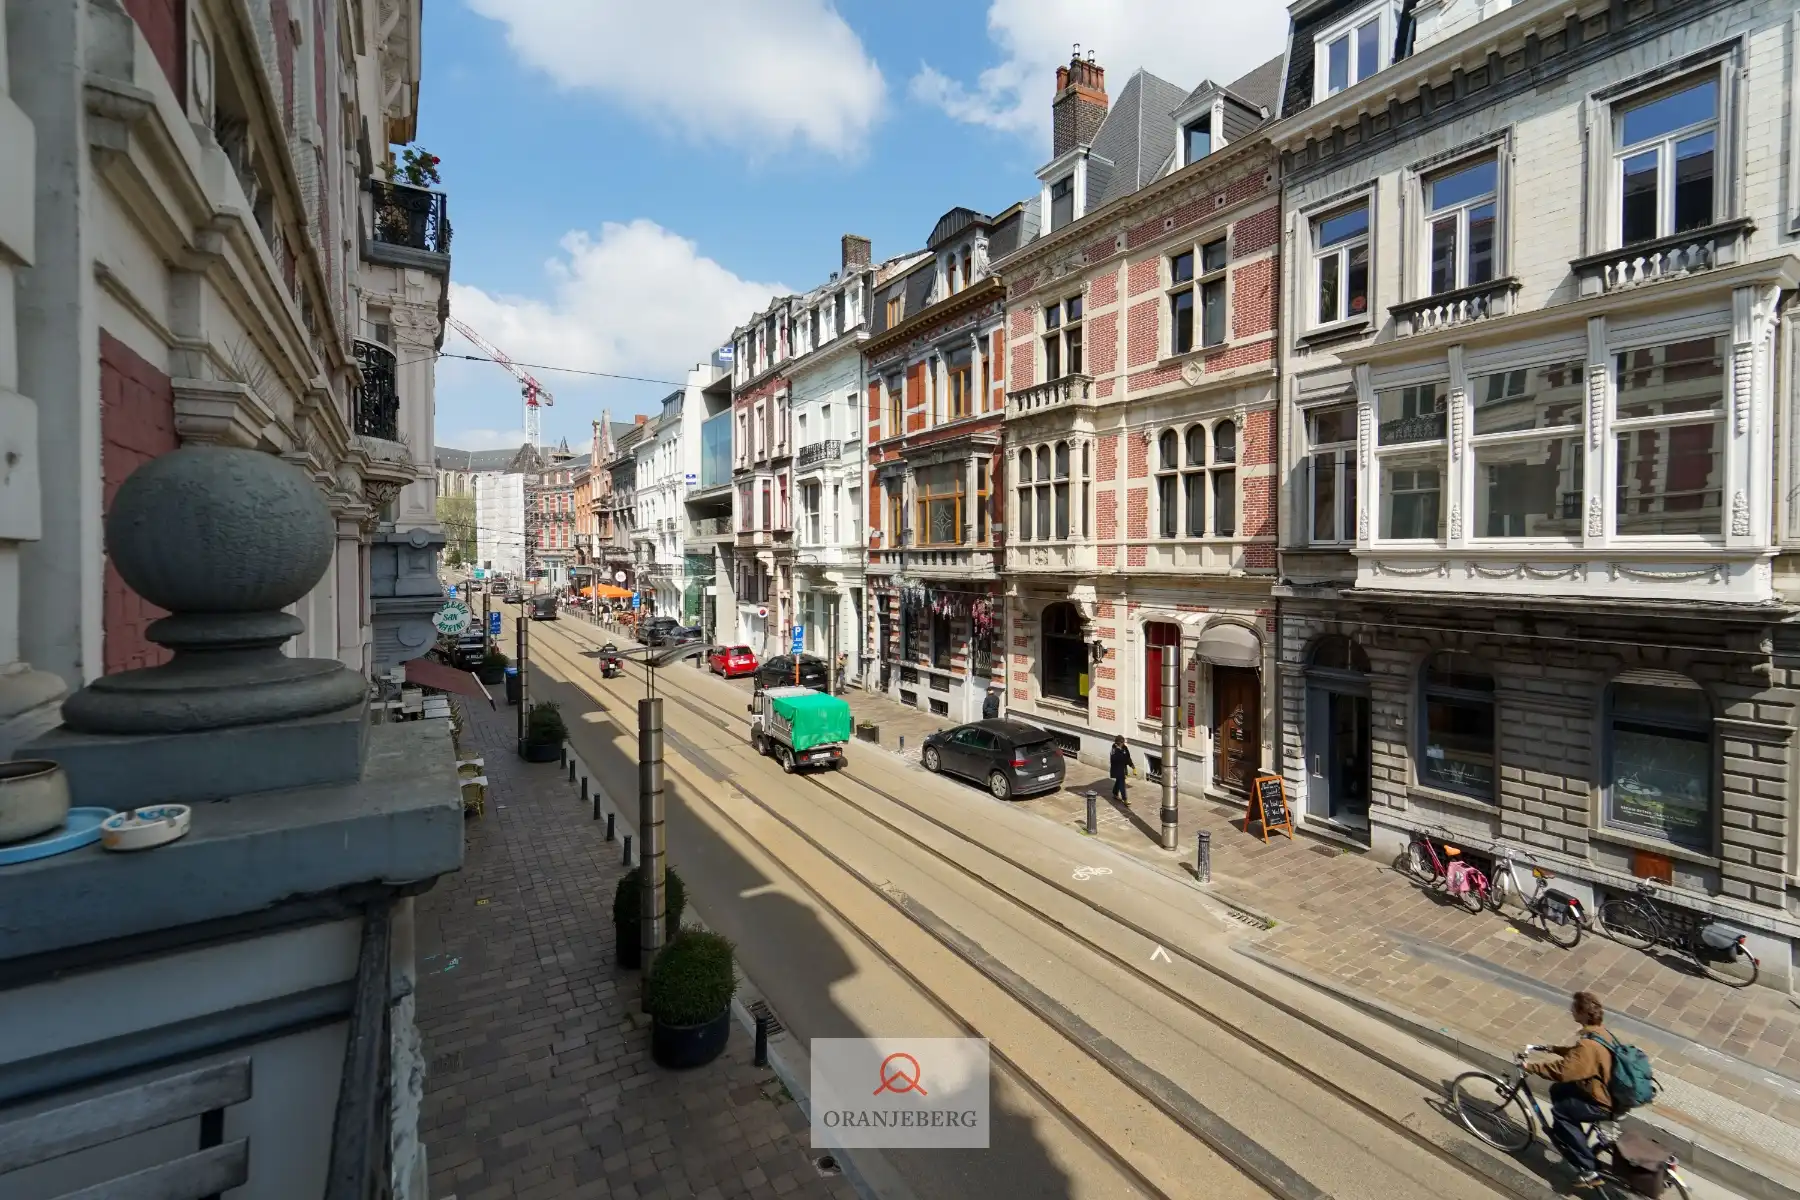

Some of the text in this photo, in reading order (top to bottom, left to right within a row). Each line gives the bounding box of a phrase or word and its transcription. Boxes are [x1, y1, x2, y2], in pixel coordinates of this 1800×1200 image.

[443, 613, 458, 621] SAN
[492, 612, 499, 621] P
[436, 620, 466, 632] MARINO
[795, 626, 801, 636] P
